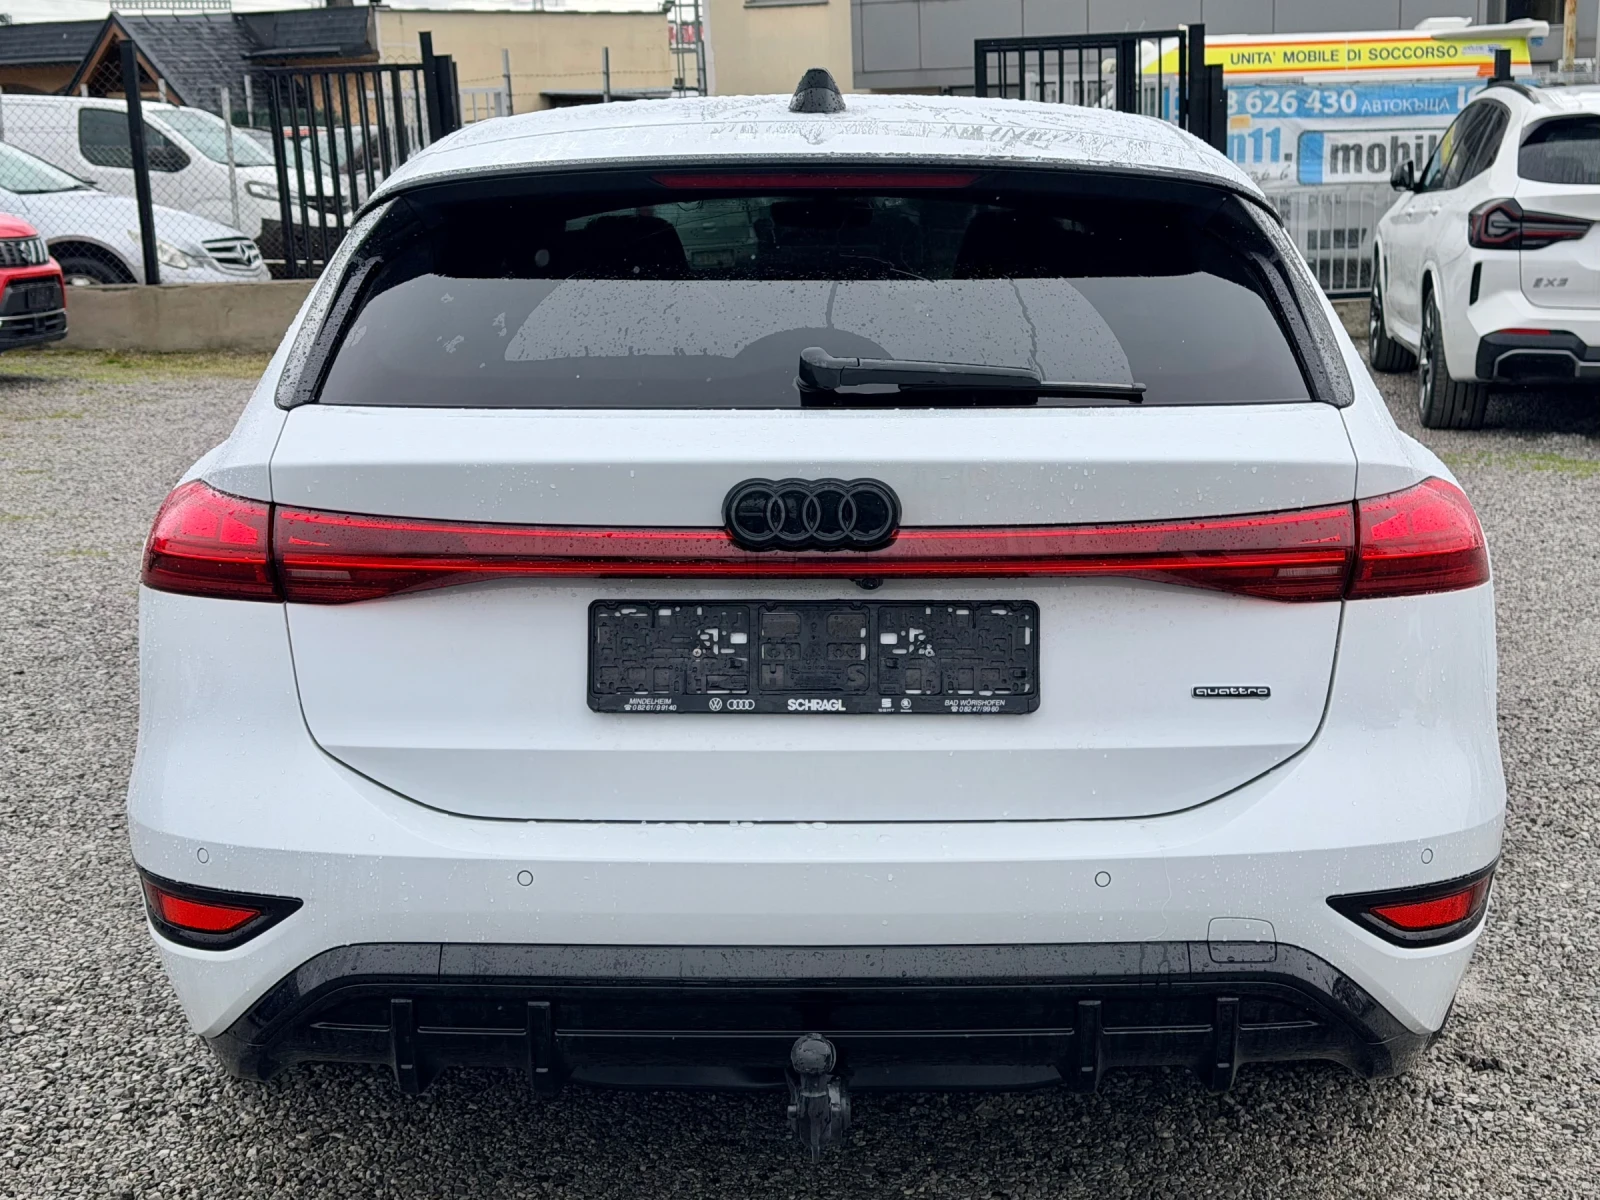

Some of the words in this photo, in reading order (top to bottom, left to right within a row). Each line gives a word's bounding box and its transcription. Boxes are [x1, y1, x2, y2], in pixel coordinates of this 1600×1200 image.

[1283, 49, 1339, 63] MOBILE
[1347, 49, 1361, 62] DI
[1368, 45, 1458, 60] SOCCORSO
[1245, 89, 1299, 114] 626
[1304, 89, 1357, 114] 430
[1196, 687, 1268, 697] quattro
[628, 697, 672, 705] MINDELHEIM
[787, 698, 846, 711] SCHRAGL
